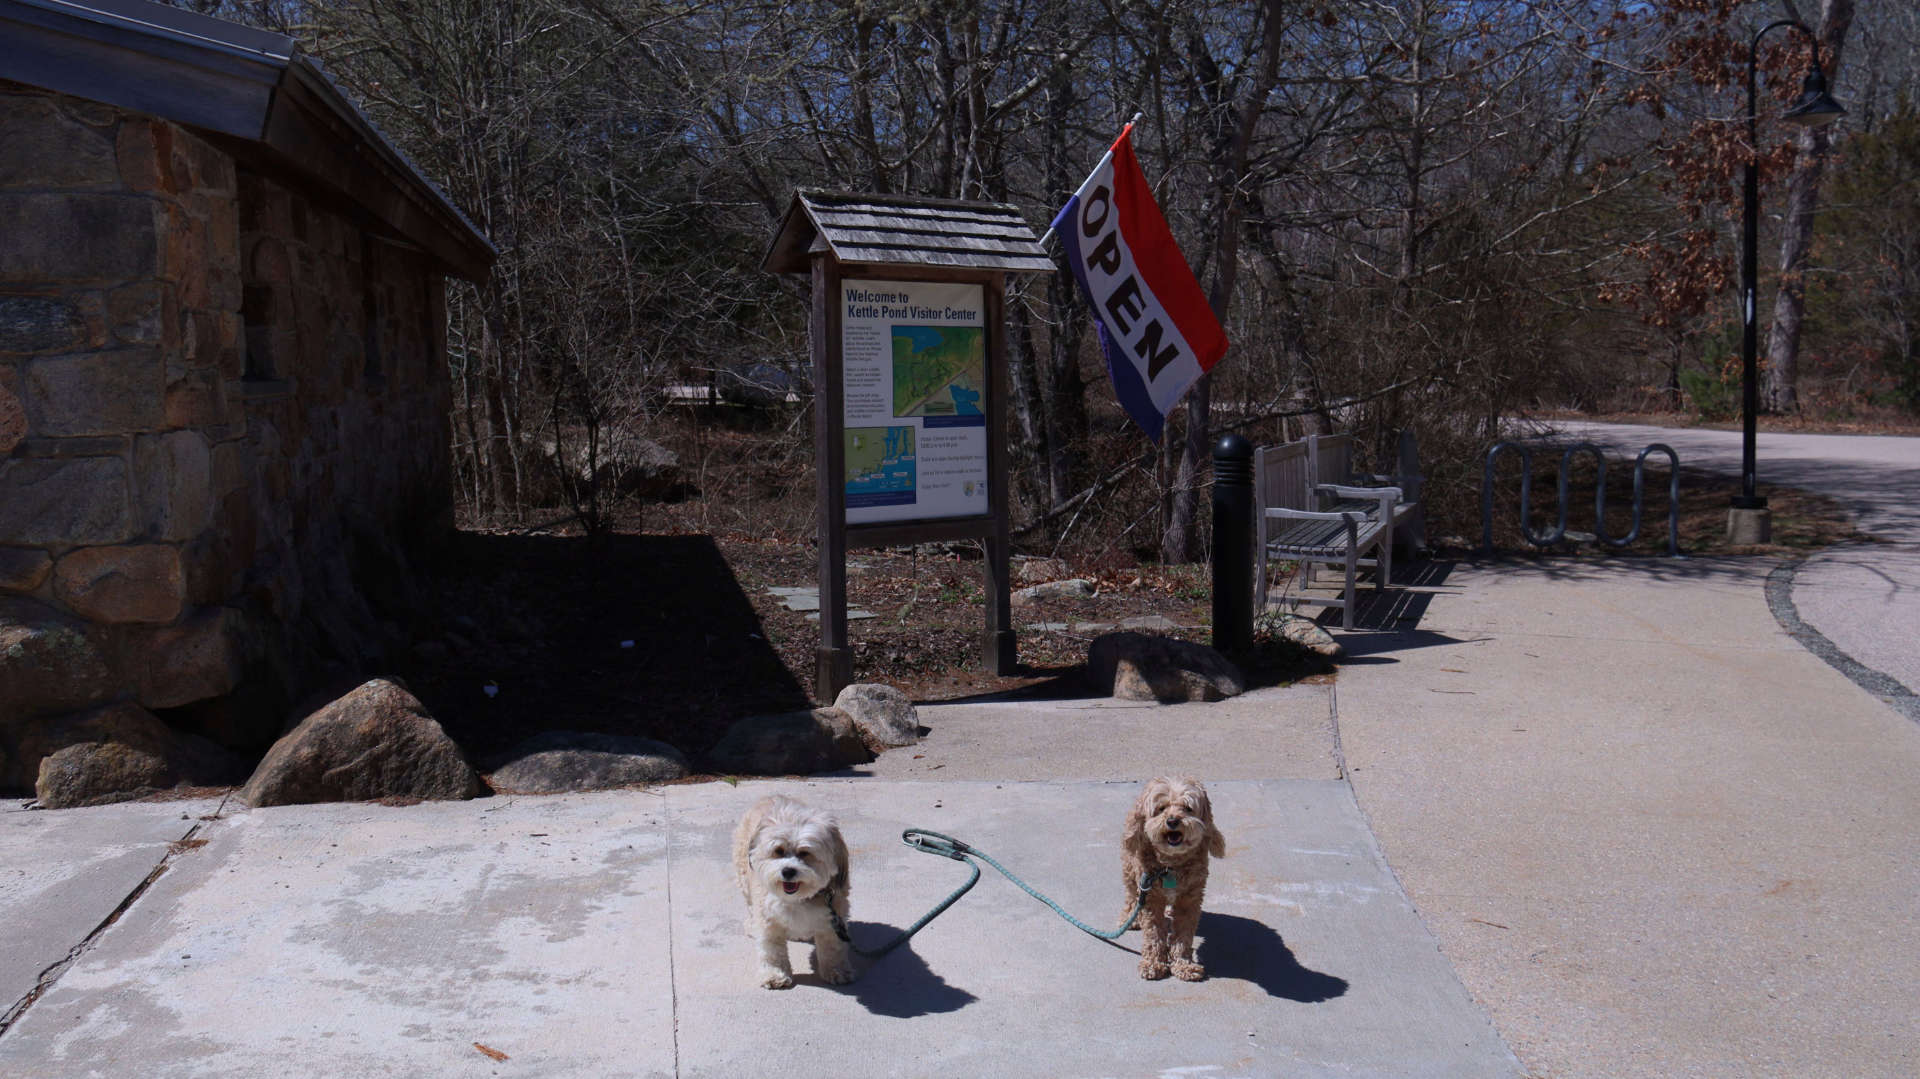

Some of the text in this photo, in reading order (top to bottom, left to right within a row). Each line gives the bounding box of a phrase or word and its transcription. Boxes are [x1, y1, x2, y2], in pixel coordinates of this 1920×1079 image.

[1081, 185, 1180, 383] OPEN
[846, 289, 909, 304] Welcome to
[848, 305, 977, 320] Kettle Pond Visitor Center
